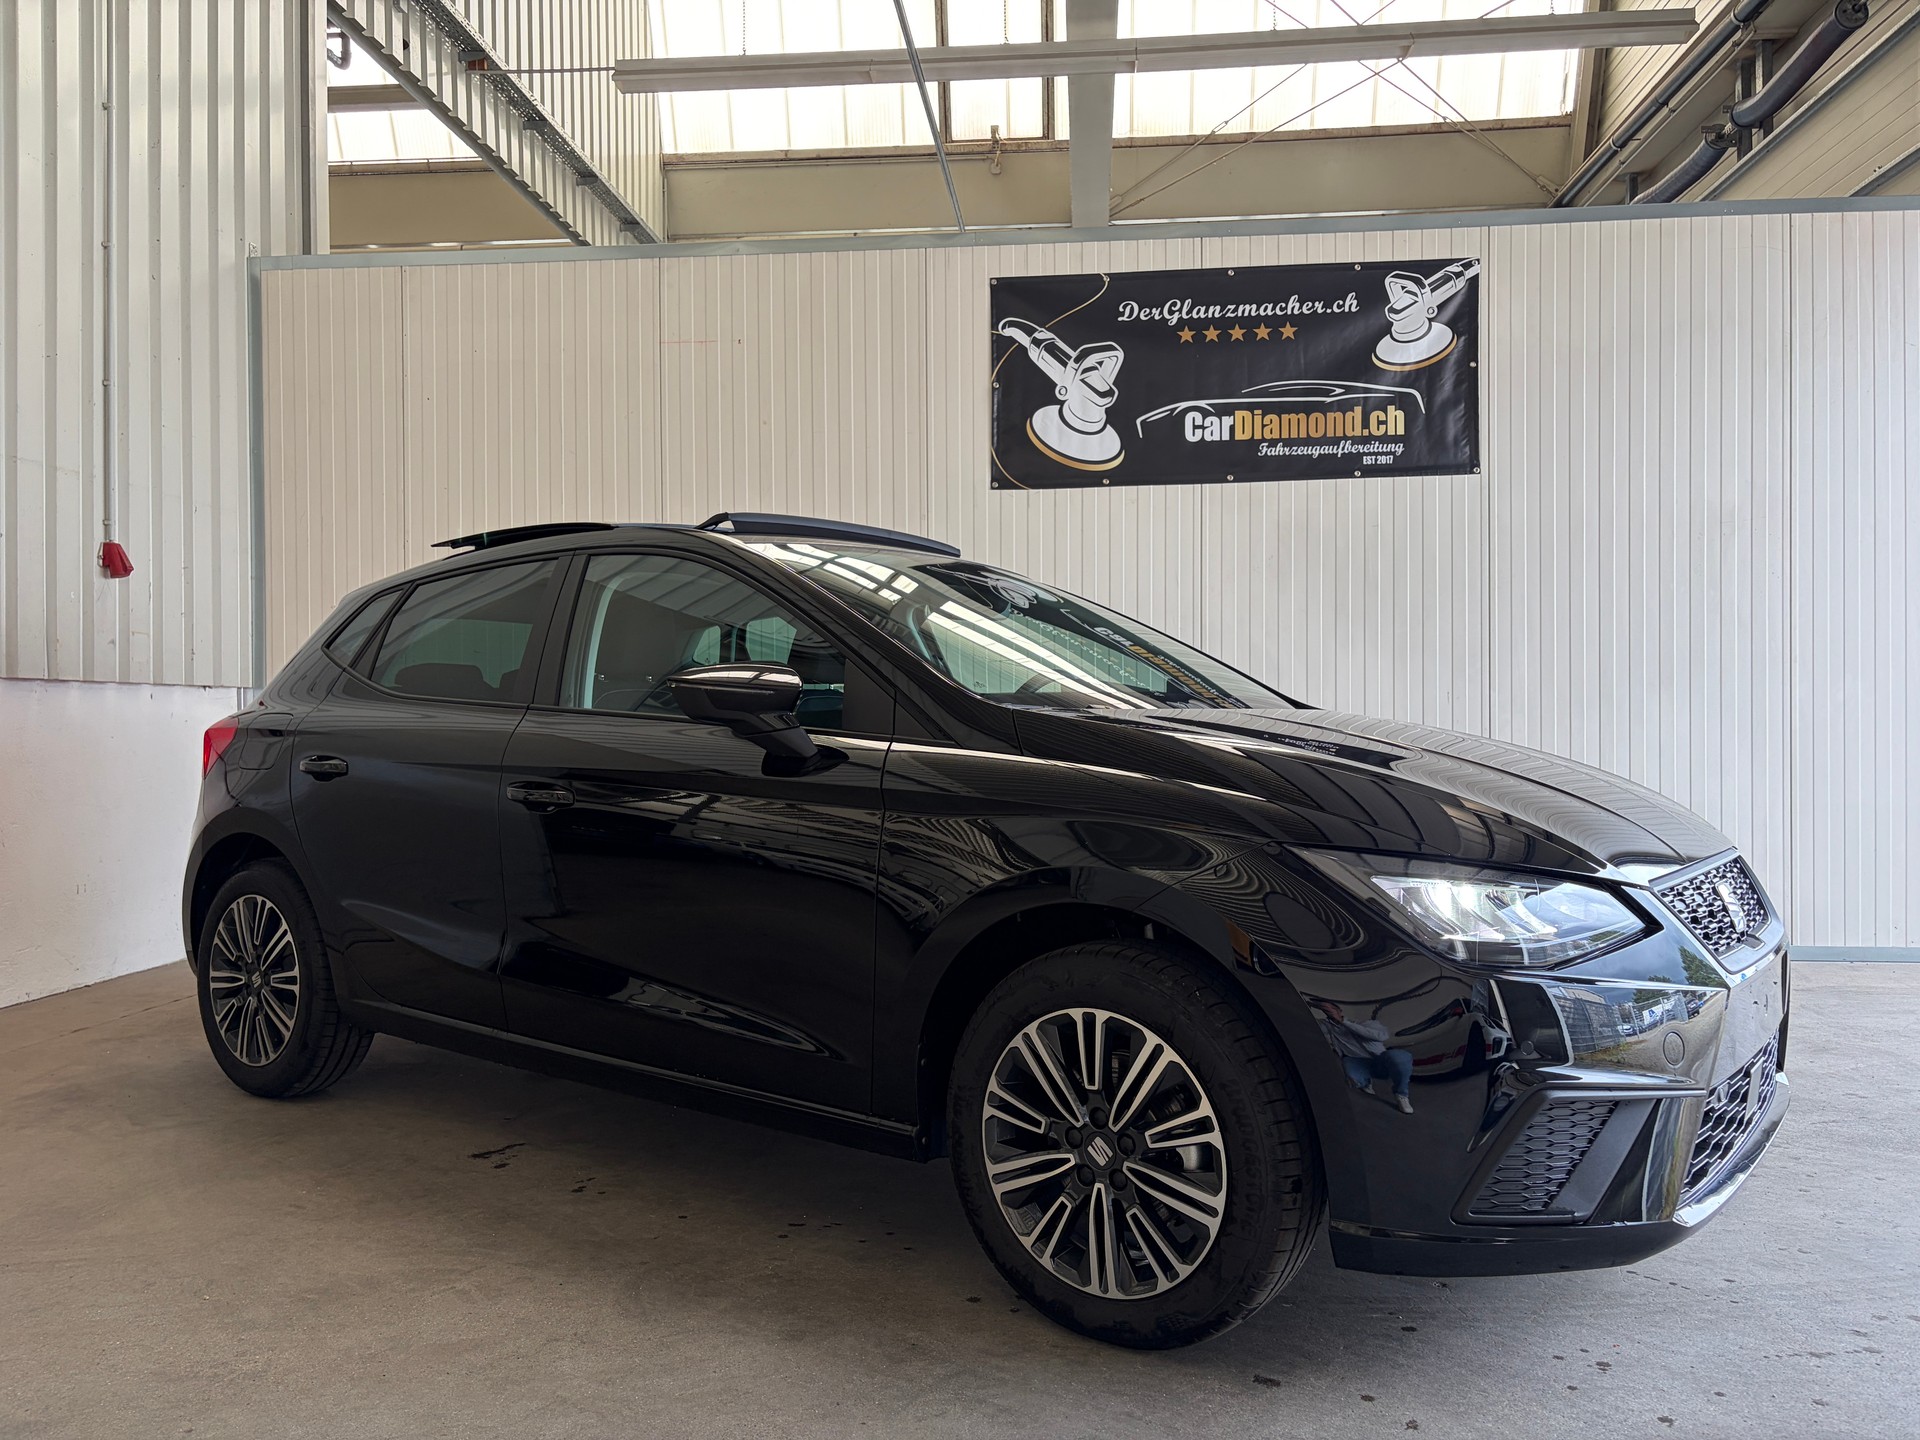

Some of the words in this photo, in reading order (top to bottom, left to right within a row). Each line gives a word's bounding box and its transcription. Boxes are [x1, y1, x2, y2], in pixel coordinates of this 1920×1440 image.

[1117, 292, 1360, 326] DerGlanzmacher.ch
[1184, 405, 1405, 442] CarDiamond.ch
[1257, 439, 1405, 458] Fahrzeugaufbereitung
[1362, 456, 1376, 465] EST
[1376, 455, 1394, 465] 2017
